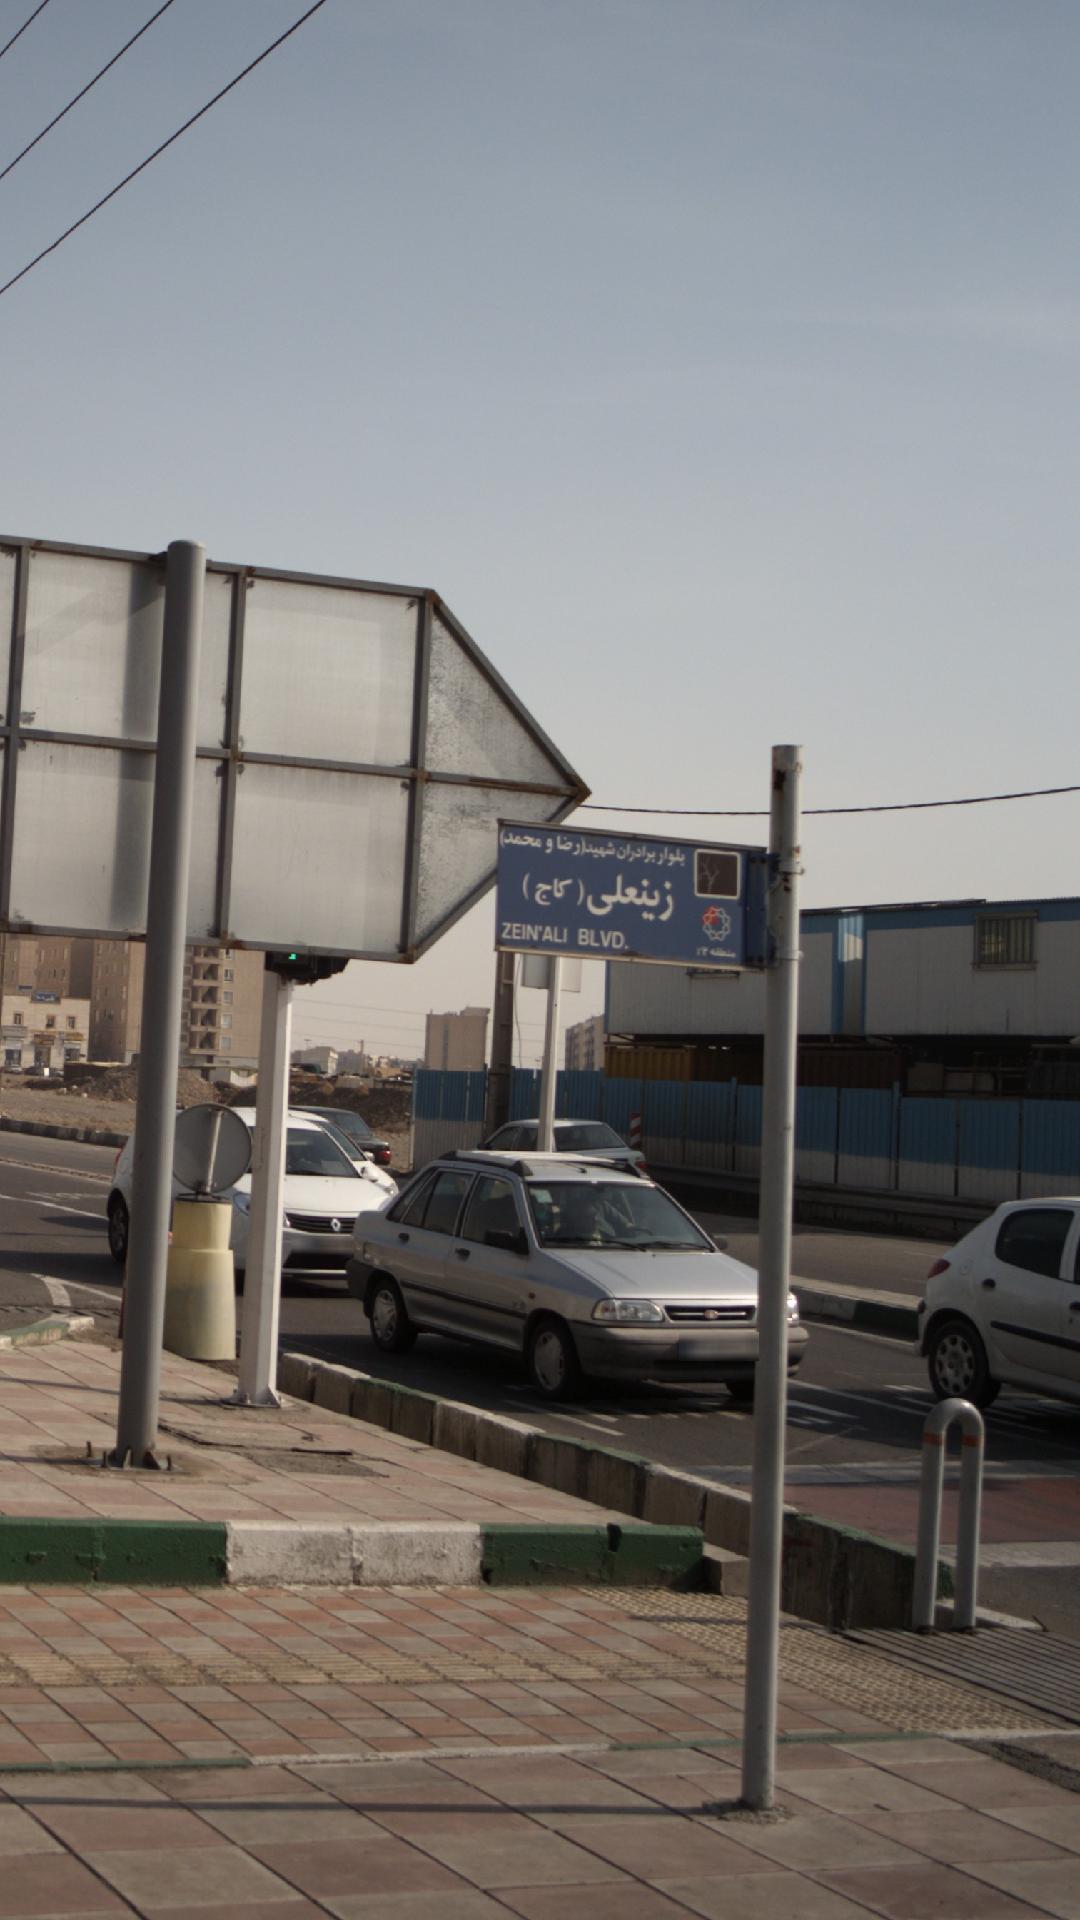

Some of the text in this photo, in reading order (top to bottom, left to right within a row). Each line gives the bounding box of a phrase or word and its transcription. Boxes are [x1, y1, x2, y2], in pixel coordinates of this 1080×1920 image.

[545, 837, 554, 854] و
[616, 843, 656, 864] برادران
[656, 846, 686, 867] بلوار
[586, 873, 674, 922] زینعلی
[501, 922, 629, 950] ZEIN'ALI BLVD.
